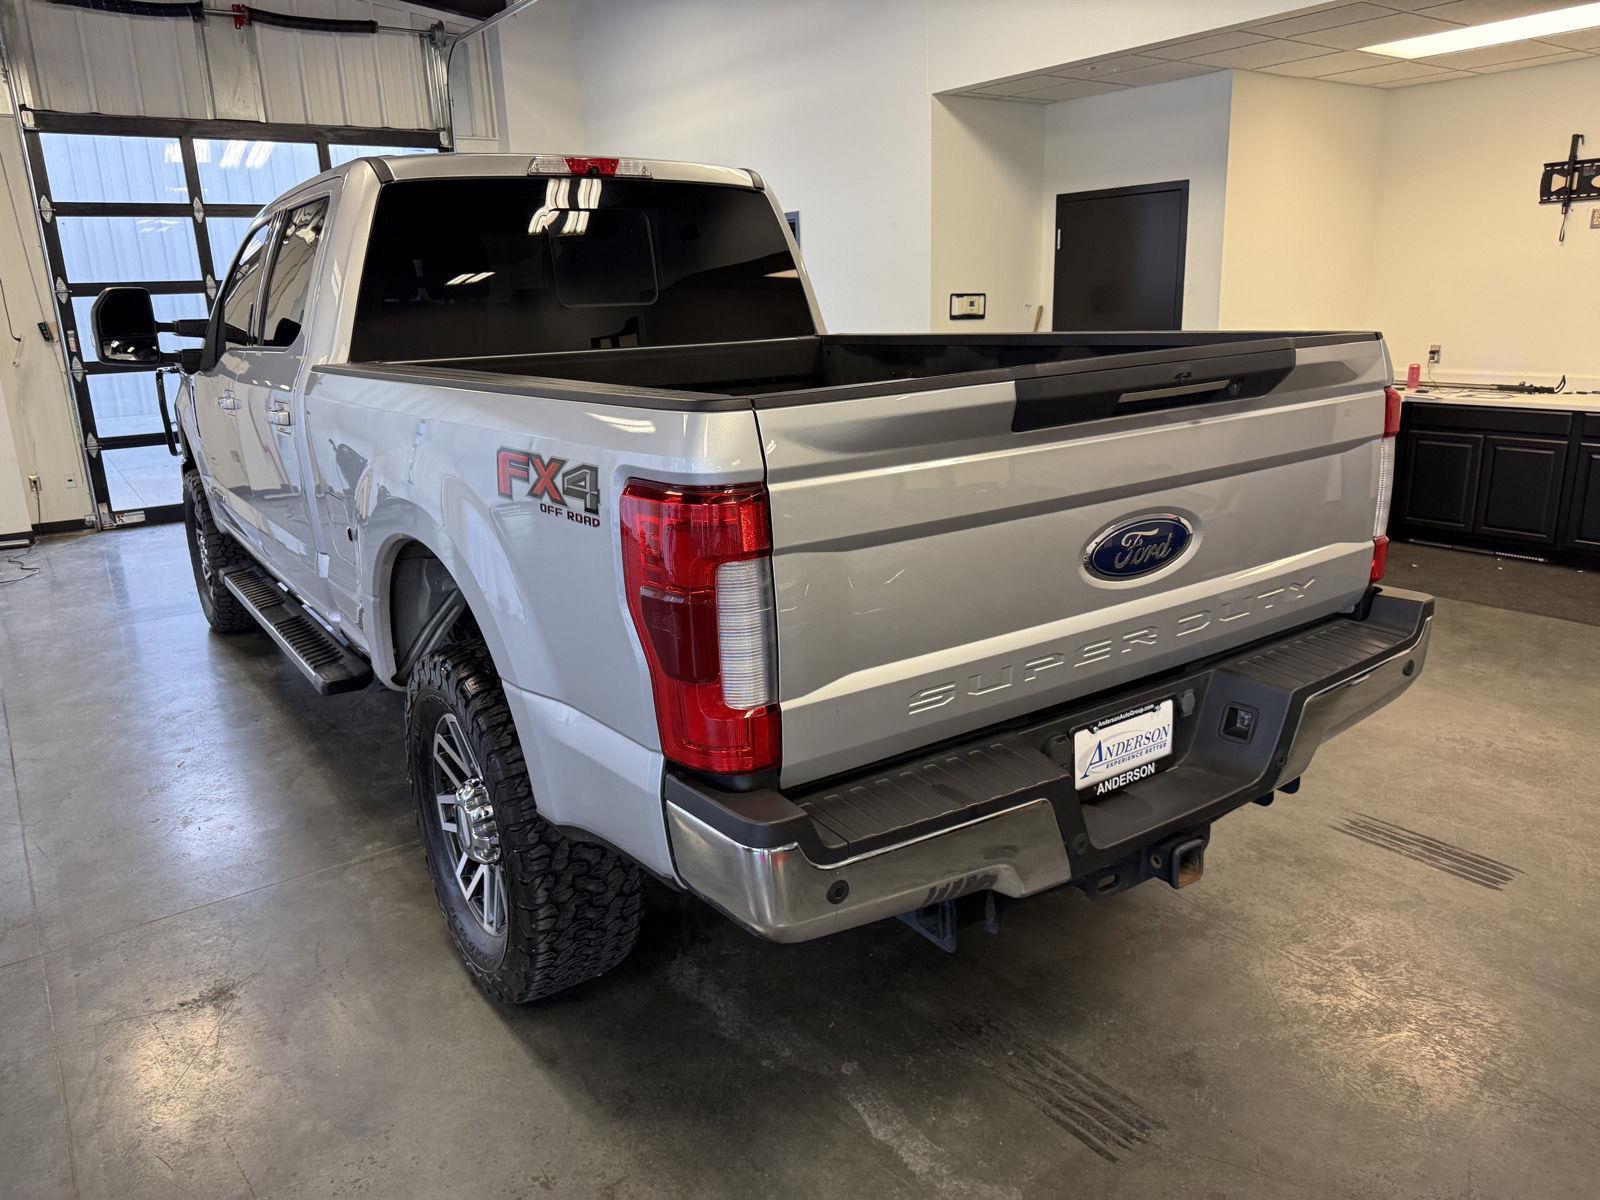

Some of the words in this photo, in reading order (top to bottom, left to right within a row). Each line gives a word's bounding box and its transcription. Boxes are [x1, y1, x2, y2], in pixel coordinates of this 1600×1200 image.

[497, 446, 600, 515] FX4
[540, 503, 563, 518] OFF
[566, 510, 601, 528] ROAD
[1114, 527, 1175, 569] Ford
[908, 625, 1159, 715] SUPER
[1176, 577, 1316, 637] DUTY
[1096, 703, 1155, 728] AndersonAutoGroup.com
[1080, 724, 1171, 780] ANDERSON
[1105, 751, 1143, 769] EXPERIENCE
[1144, 742, 1168, 755] BETTER
[1096, 762, 1156, 796] ANDERSON
